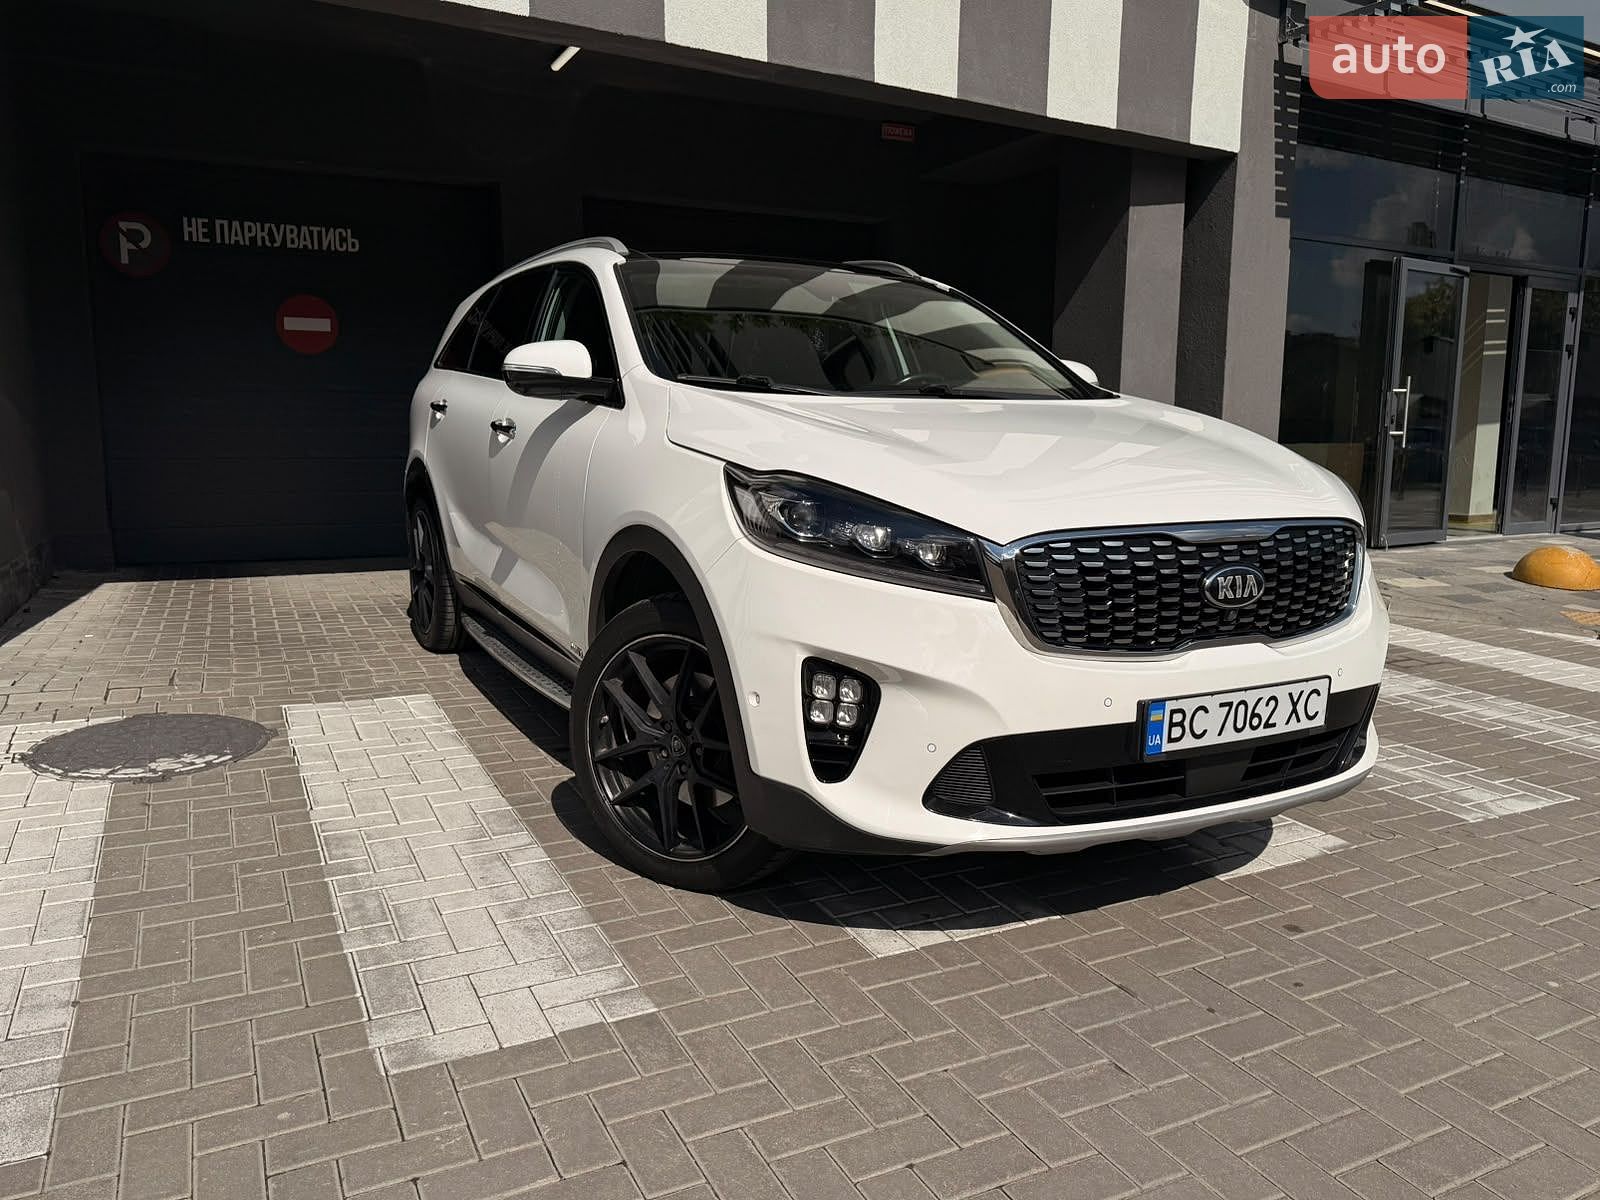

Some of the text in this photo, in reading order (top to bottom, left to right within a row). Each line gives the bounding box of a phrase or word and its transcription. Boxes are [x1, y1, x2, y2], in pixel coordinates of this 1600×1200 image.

[182, 216, 360, 253] НЕ ПАРКУВАТИСЬ
[1217, 574, 1258, 600] KIA
[1167, 688, 1321, 744] BC 7062 XC
[1148, 733, 1161, 746] UA
